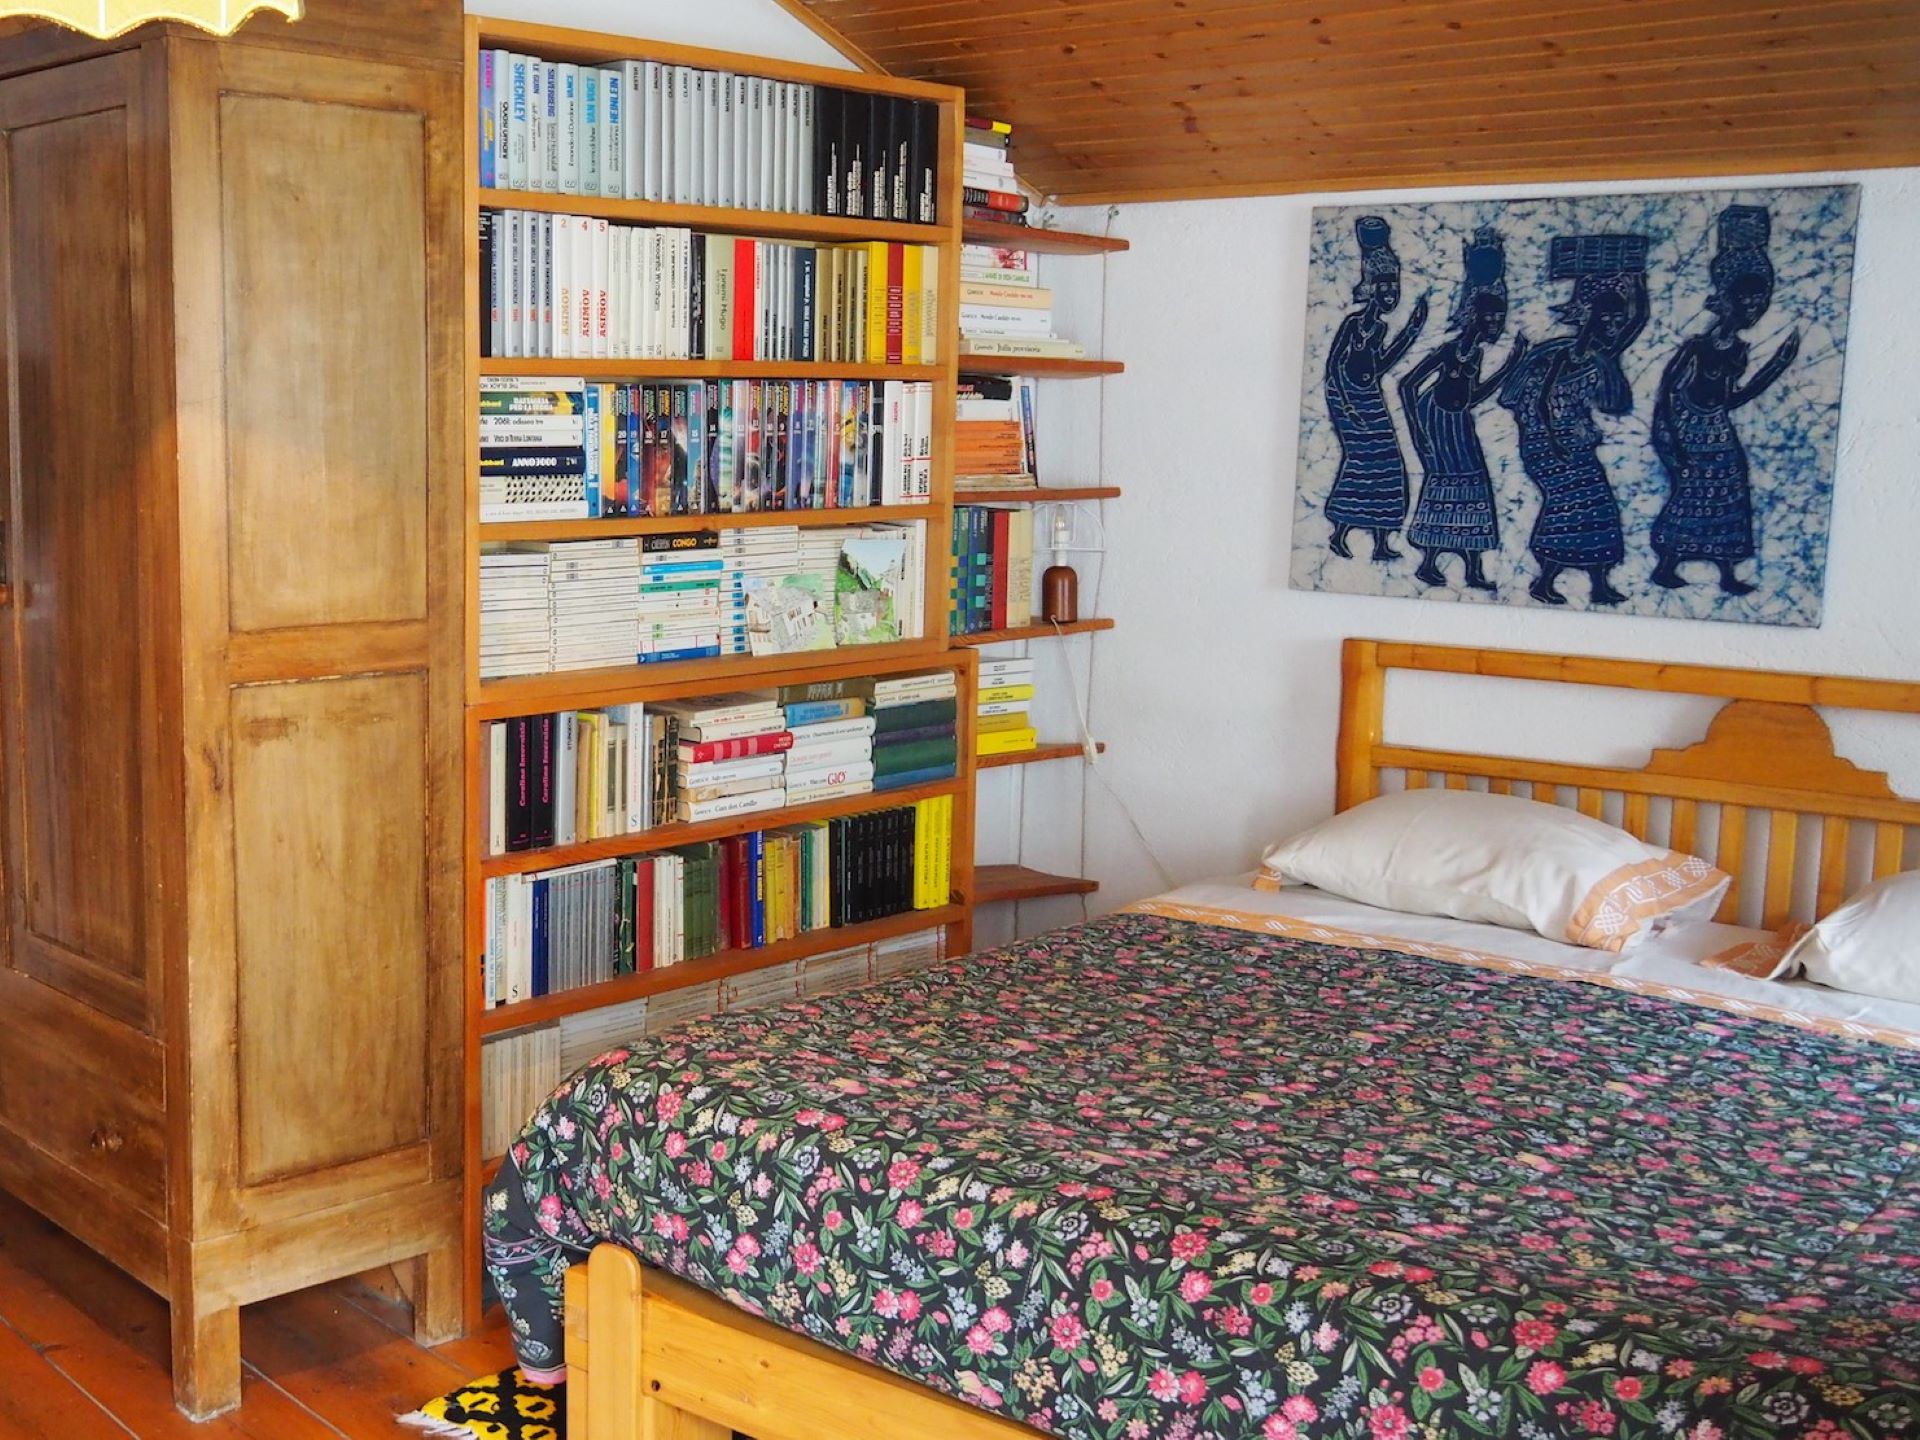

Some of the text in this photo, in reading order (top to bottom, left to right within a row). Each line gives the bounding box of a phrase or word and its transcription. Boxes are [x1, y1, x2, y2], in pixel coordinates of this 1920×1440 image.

[514, 63, 526, 122] SHECKLEY
[547, 68, 556, 117] SILVERBERG
[587, 77, 596, 123] VAN VOGT
[609, 77, 619, 124] HEINLEIN
[561, 288, 569, 336] ASIMOV
[582, 289, 590, 337] ASIMOV
[719, 304, 728, 330] Hugo
[672, 538, 697, 548] CONGO
